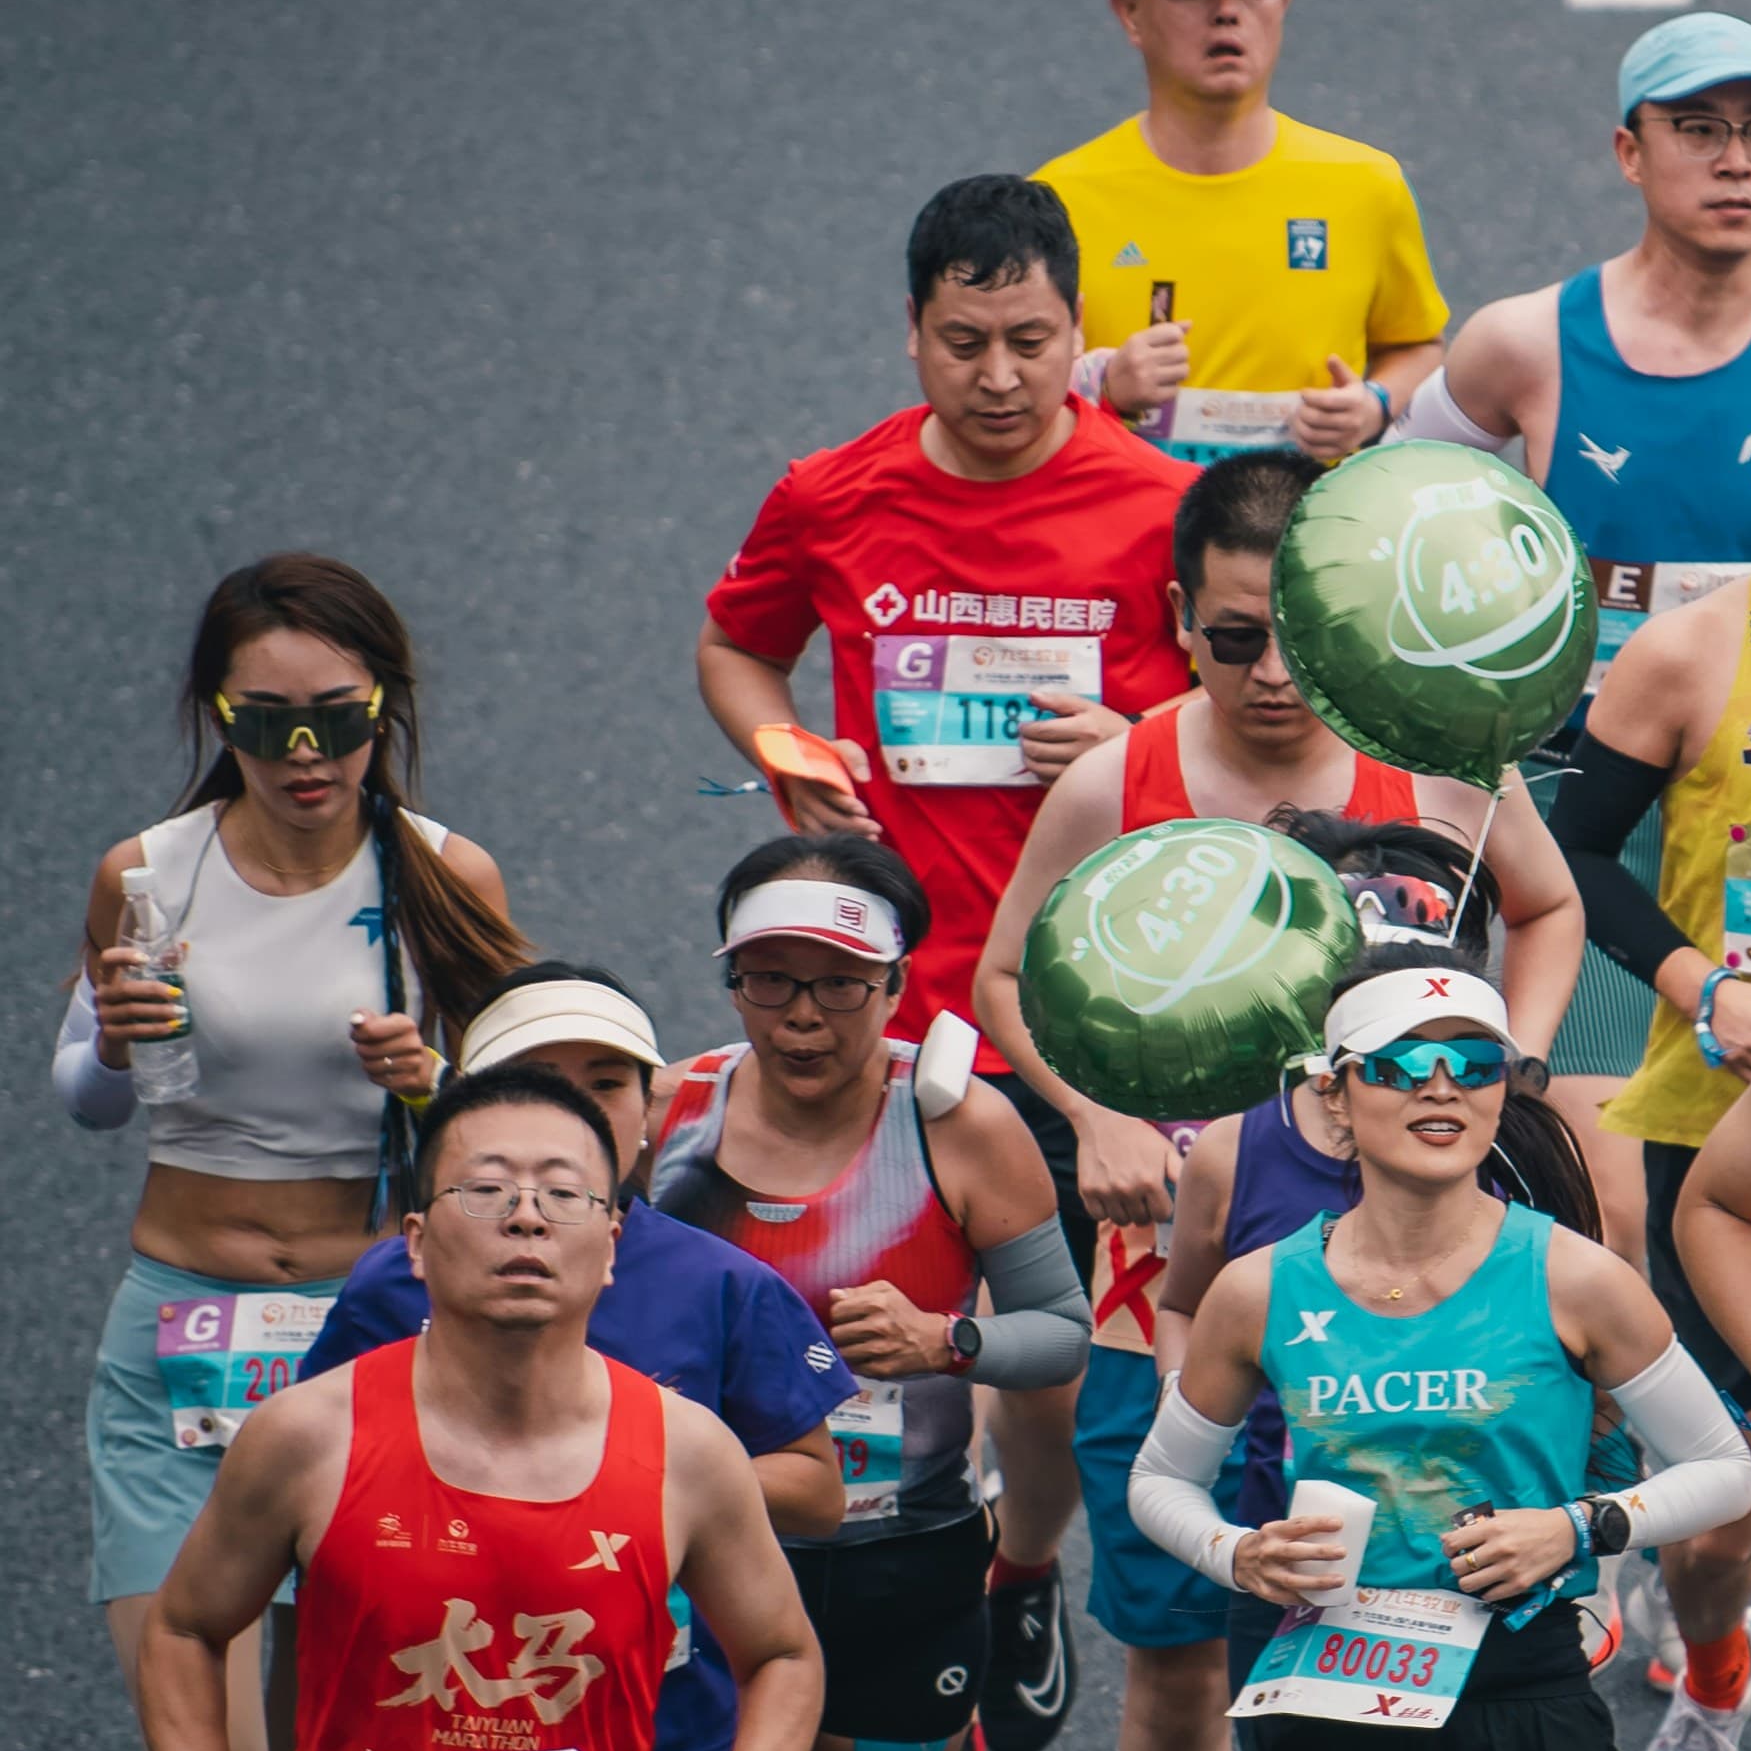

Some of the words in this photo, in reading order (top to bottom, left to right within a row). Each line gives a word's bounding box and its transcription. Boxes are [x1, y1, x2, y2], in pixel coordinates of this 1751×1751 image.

[1441, 524, 1548, 616] 4:30
[1608, 565, 1643, 601] E
[912, 589, 1118, 631] 山西惠民医院
[896, 642, 933, 679] G
[1135, 844, 1238, 955] 4:30
[184, 1304, 222, 1342] G
[1306, 1368, 1494, 1418] PACER
[1316, 1632, 1440, 1688] 80033
[431, 1729, 541, 1751] MARATHON
[451, 1713, 535, 1735] TAIYUAN
